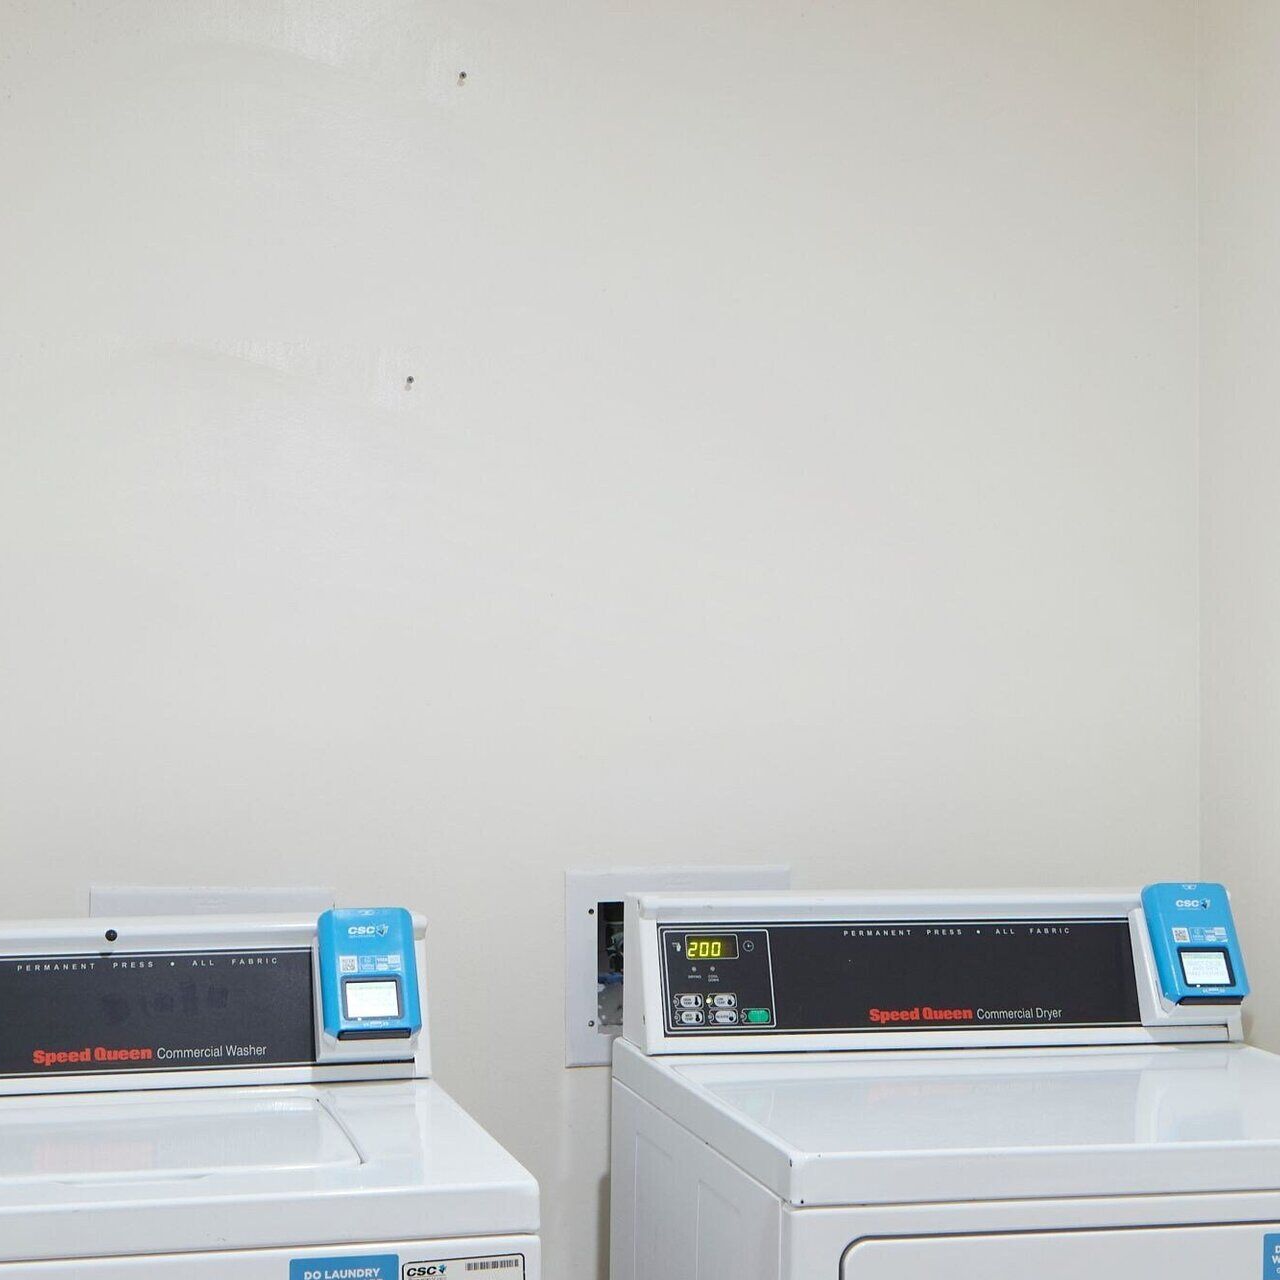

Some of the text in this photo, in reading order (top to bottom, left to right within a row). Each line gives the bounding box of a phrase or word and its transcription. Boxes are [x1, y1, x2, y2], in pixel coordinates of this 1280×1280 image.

[1175, 899, 1199, 908] CSC
[347, 926, 375, 935] CSC
[843, 929, 912, 937] PERMANENT
[926, 928, 962, 936] PRESS
[1029, 927, 1071, 935] FABRIC
[687, 941, 721, 957] 200
[17, 957, 279, 972] PERMANENT PRESS ALL FABRIC
[869, 1007, 1062, 1023] Speed Queen Commercial Dryer
[33, 1044, 267, 1066] Speed Queen Commercial Washer
[304, 1268, 380, 1280] DO LAUNDRY
[406, 1266, 437, 1277] CSC
